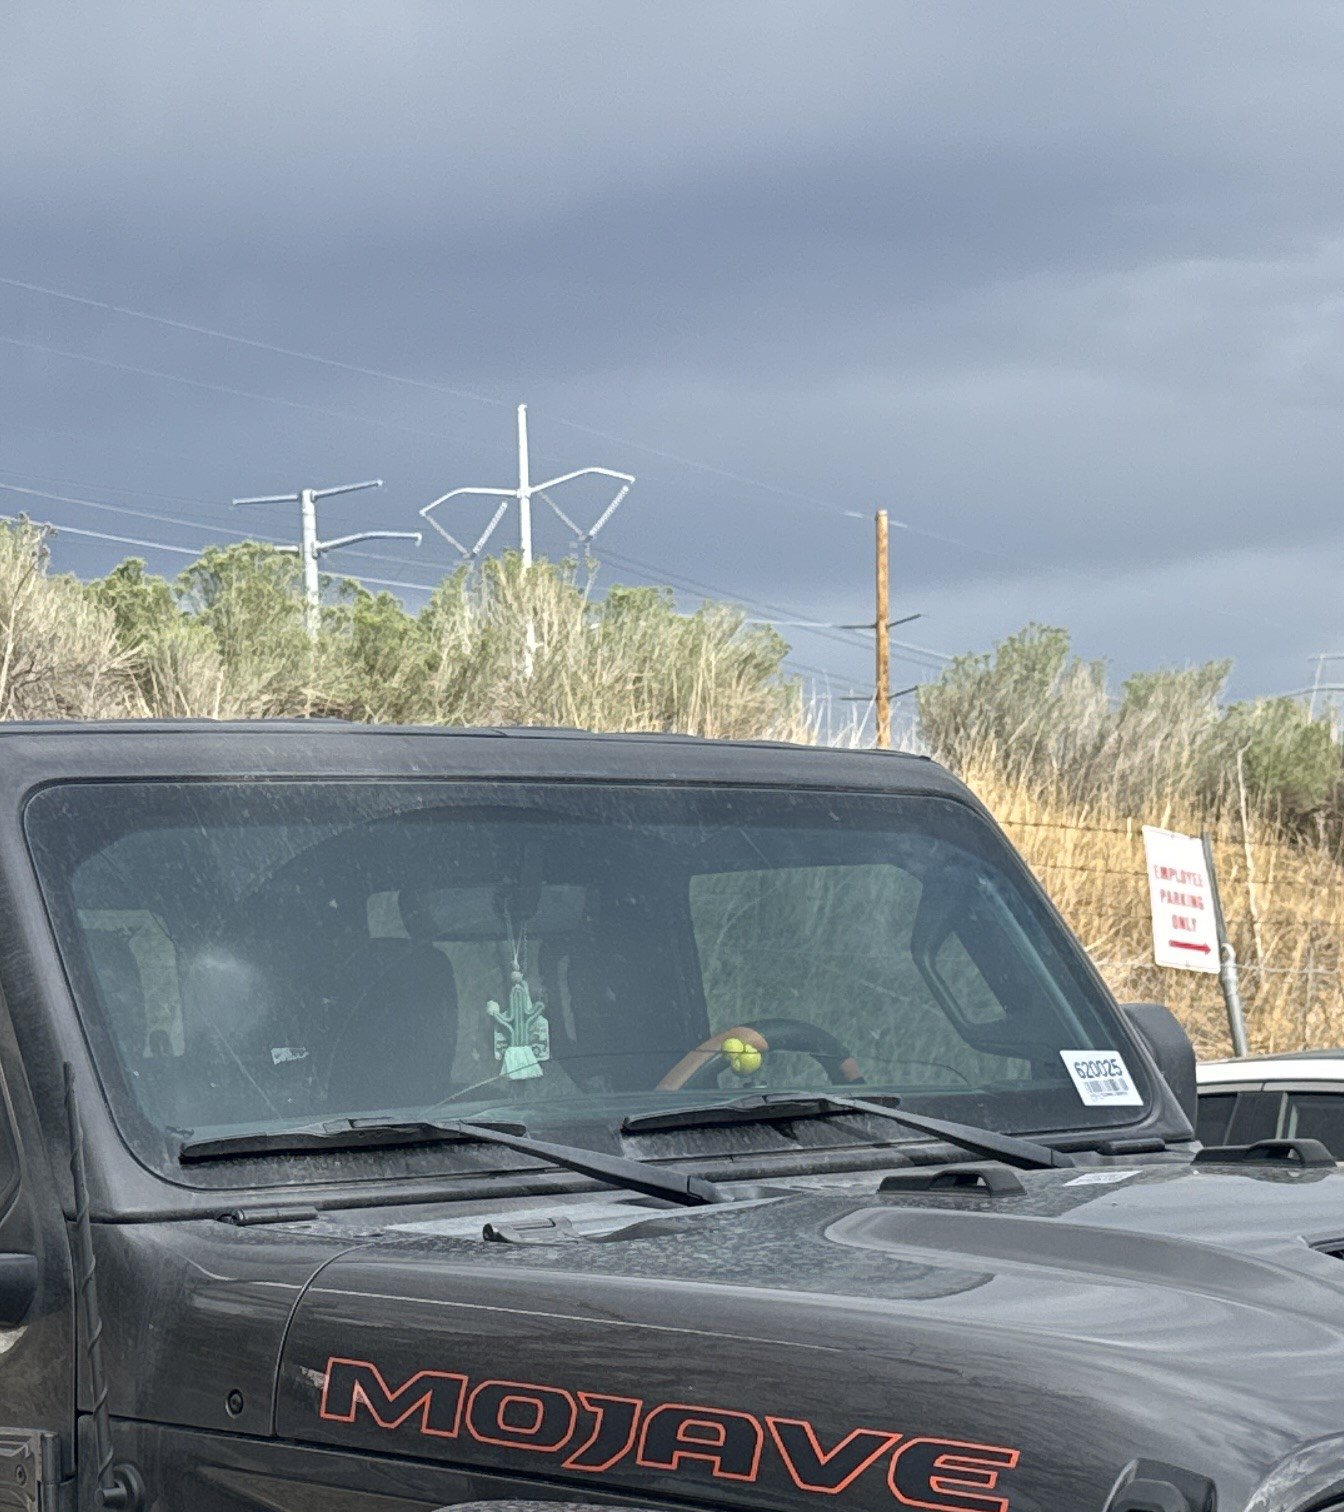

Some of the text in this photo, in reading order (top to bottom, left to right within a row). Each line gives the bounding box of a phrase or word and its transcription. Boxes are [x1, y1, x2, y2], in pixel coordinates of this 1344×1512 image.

[1160, 889, 1204, 910] PARKING
[1172, 915, 1197, 932] ONLY
[1073, 1059, 1123, 1079] 620025
